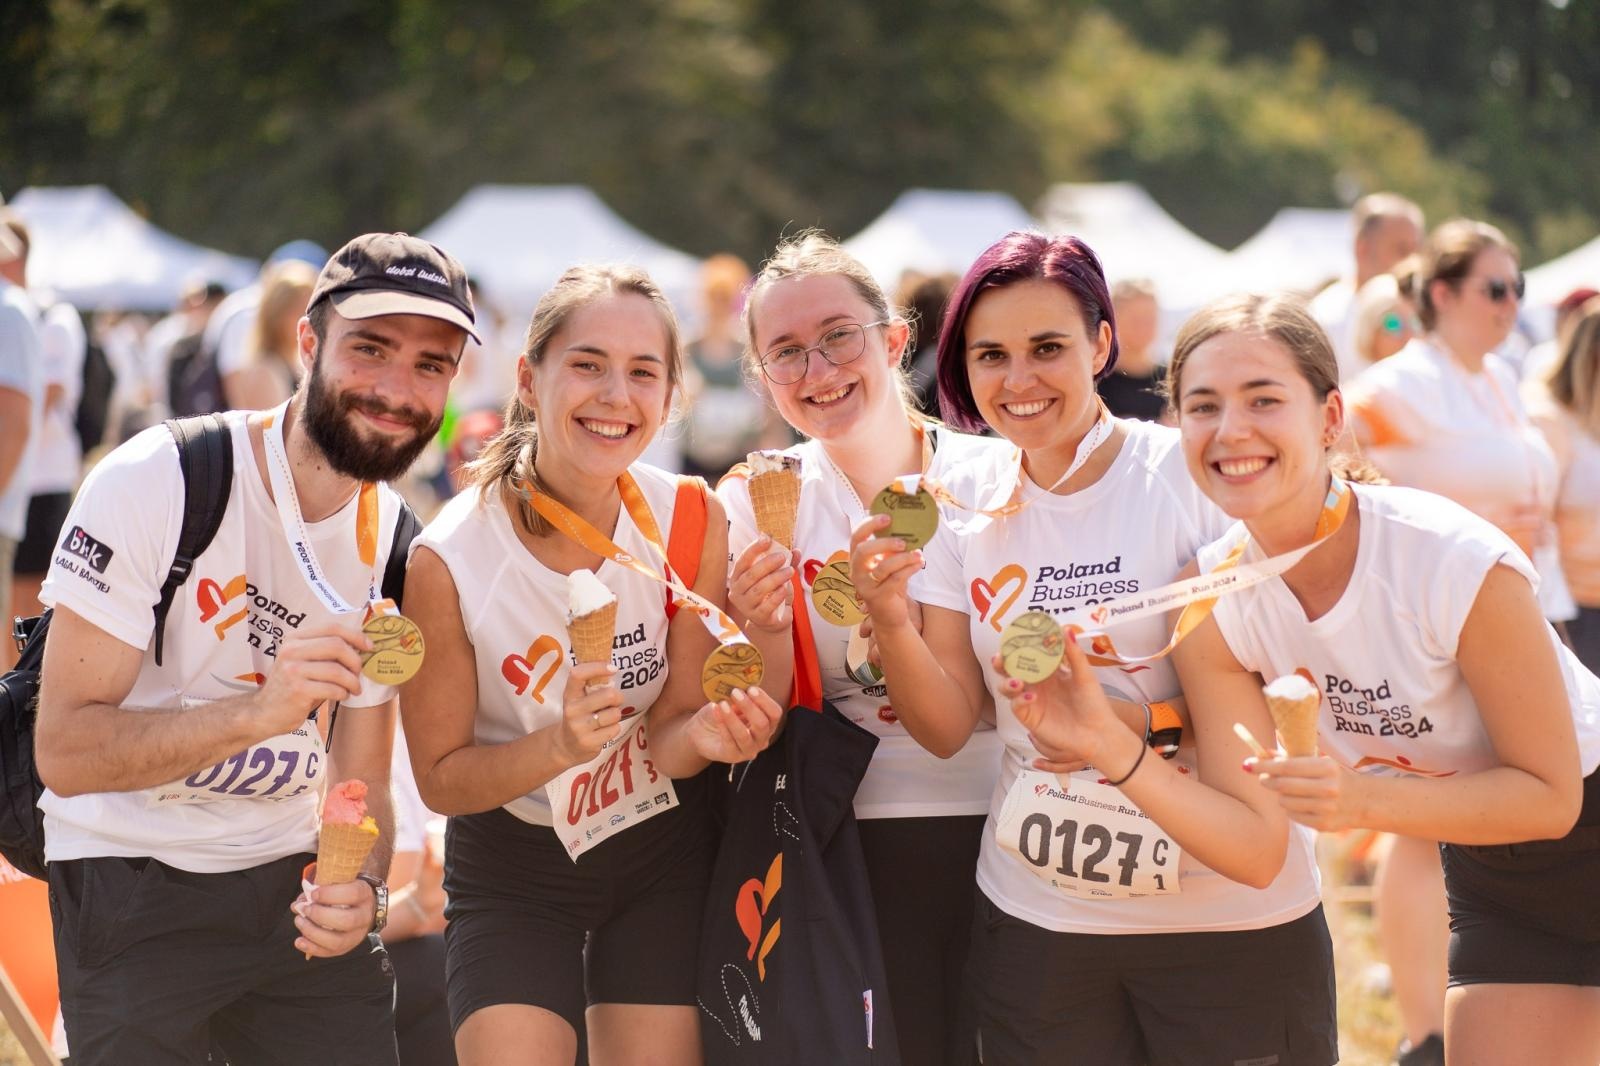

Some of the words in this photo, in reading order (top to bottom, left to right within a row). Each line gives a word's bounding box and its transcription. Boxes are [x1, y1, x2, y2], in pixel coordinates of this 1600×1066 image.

[1035, 556, 1121, 582] Poland
[1029, 579, 1139, 602] Business
[1110, 601, 1144, 616] Poland
[1191, 585, 1210, 594] Run
[1212, 576, 1237, 589] 2024
[637, 725, 647, 750] C
[1334, 715, 1375, 736] Run
[305, 752, 319, 779] C
[643, 760, 658, 784] 3
[567, 735, 634, 826] 0127
[1047, 788, 1077, 802] Poland
[1078, 796, 1117, 812] Business
[1117, 805, 1137, 817] Run
[1019, 812, 1143, 887] 0127
[1152, 838, 1169, 867] C
[1153, 873, 1167, 890] 1
